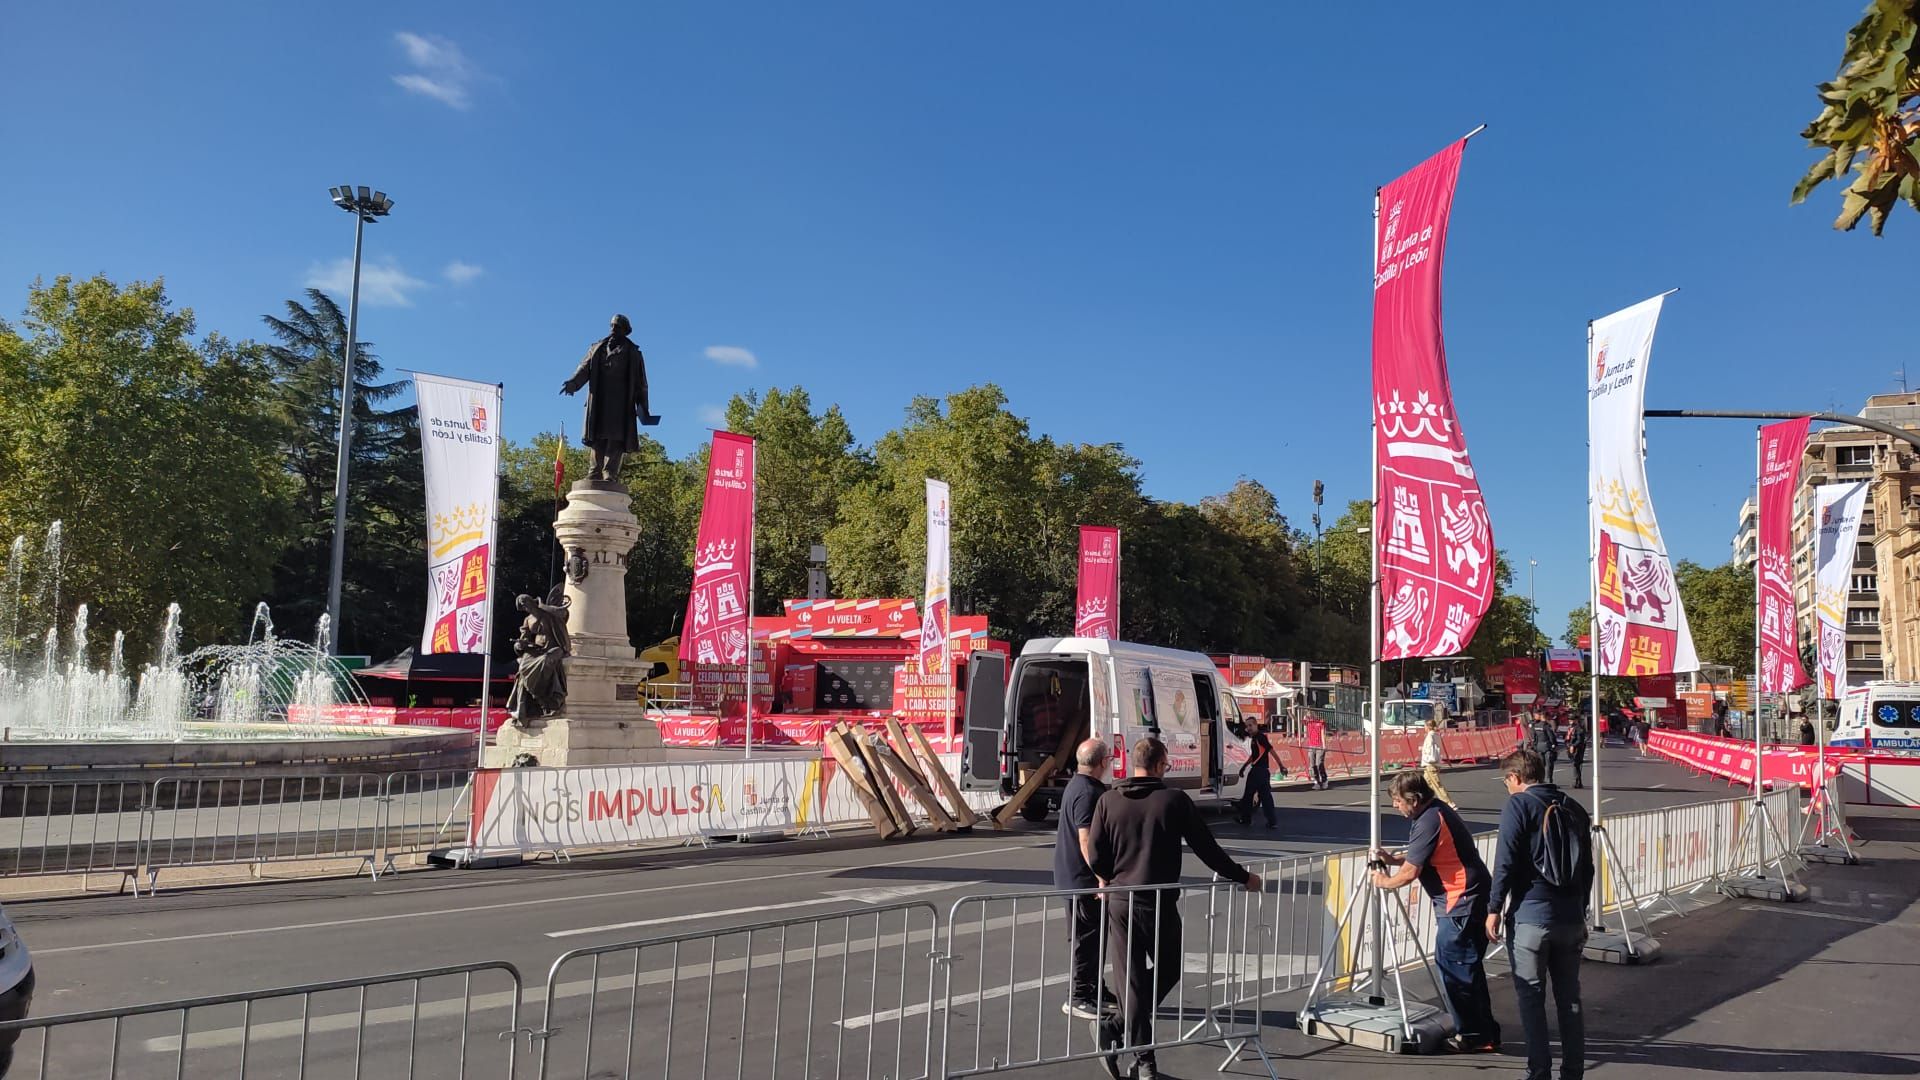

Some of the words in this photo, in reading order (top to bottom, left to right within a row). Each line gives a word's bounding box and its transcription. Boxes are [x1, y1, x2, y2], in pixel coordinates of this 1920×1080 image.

[1393, 232, 1419, 258] Junta
[1374, 263, 1397, 290] Castilla
[1397, 259, 1406, 279] y
[1404, 246, 1429, 270] León
[1604, 361, 1625, 379] Junta
[1625, 357, 1636, 370] de
[1613, 373, 1633, 390] León
[827, 614, 836, 625] LA
[836, 614, 862, 625] VUELTA
[863, 614, 872, 624] 25
[923, 686, 956, 698] SEGUNO
[908, 699, 927, 711] CADA
[417, 718, 439, 727] VUELTA
[464, 717, 473, 726] LA
[473, 717, 495, 726] VUTA
[674, 727, 682, 736] LA
[682, 727, 706, 737] VUELTA
[783, 728, 807, 738] VUELTA
[1792, 763, 1807, 776] LA
[587, 783, 726, 826] IMPULSA
